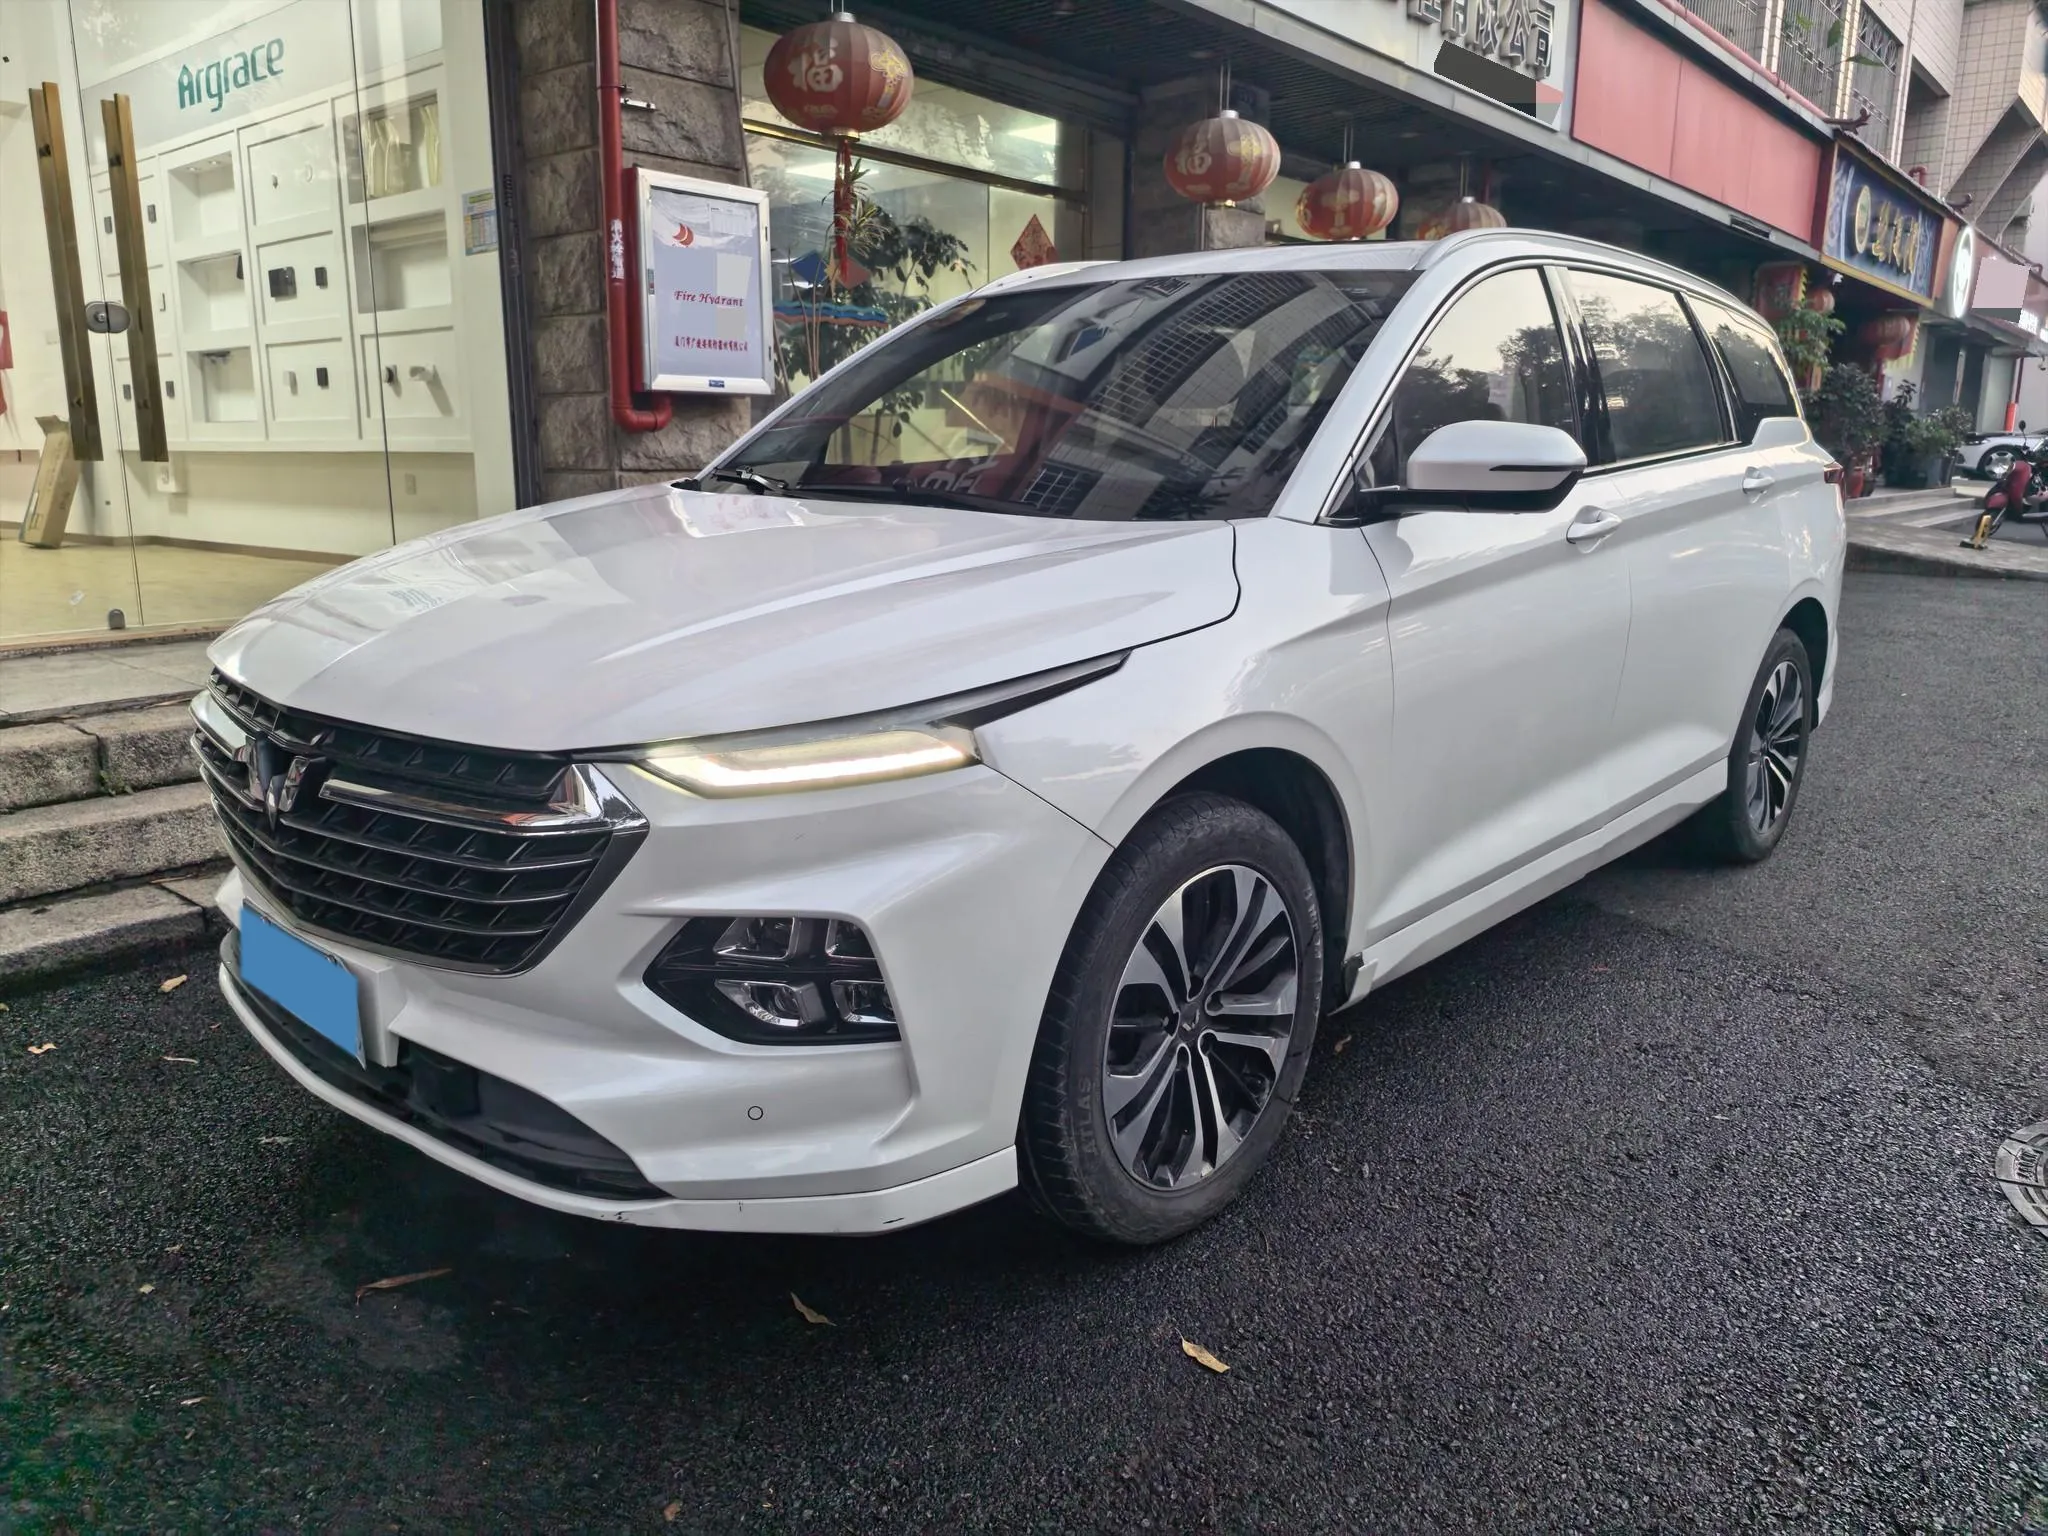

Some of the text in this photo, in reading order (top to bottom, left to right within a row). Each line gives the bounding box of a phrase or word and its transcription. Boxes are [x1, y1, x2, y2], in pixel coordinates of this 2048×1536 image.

[178, 38, 284, 113] Argrace
[787, 37, 844, 93] 福
[674, 290, 745, 307] Fire Hydrant
